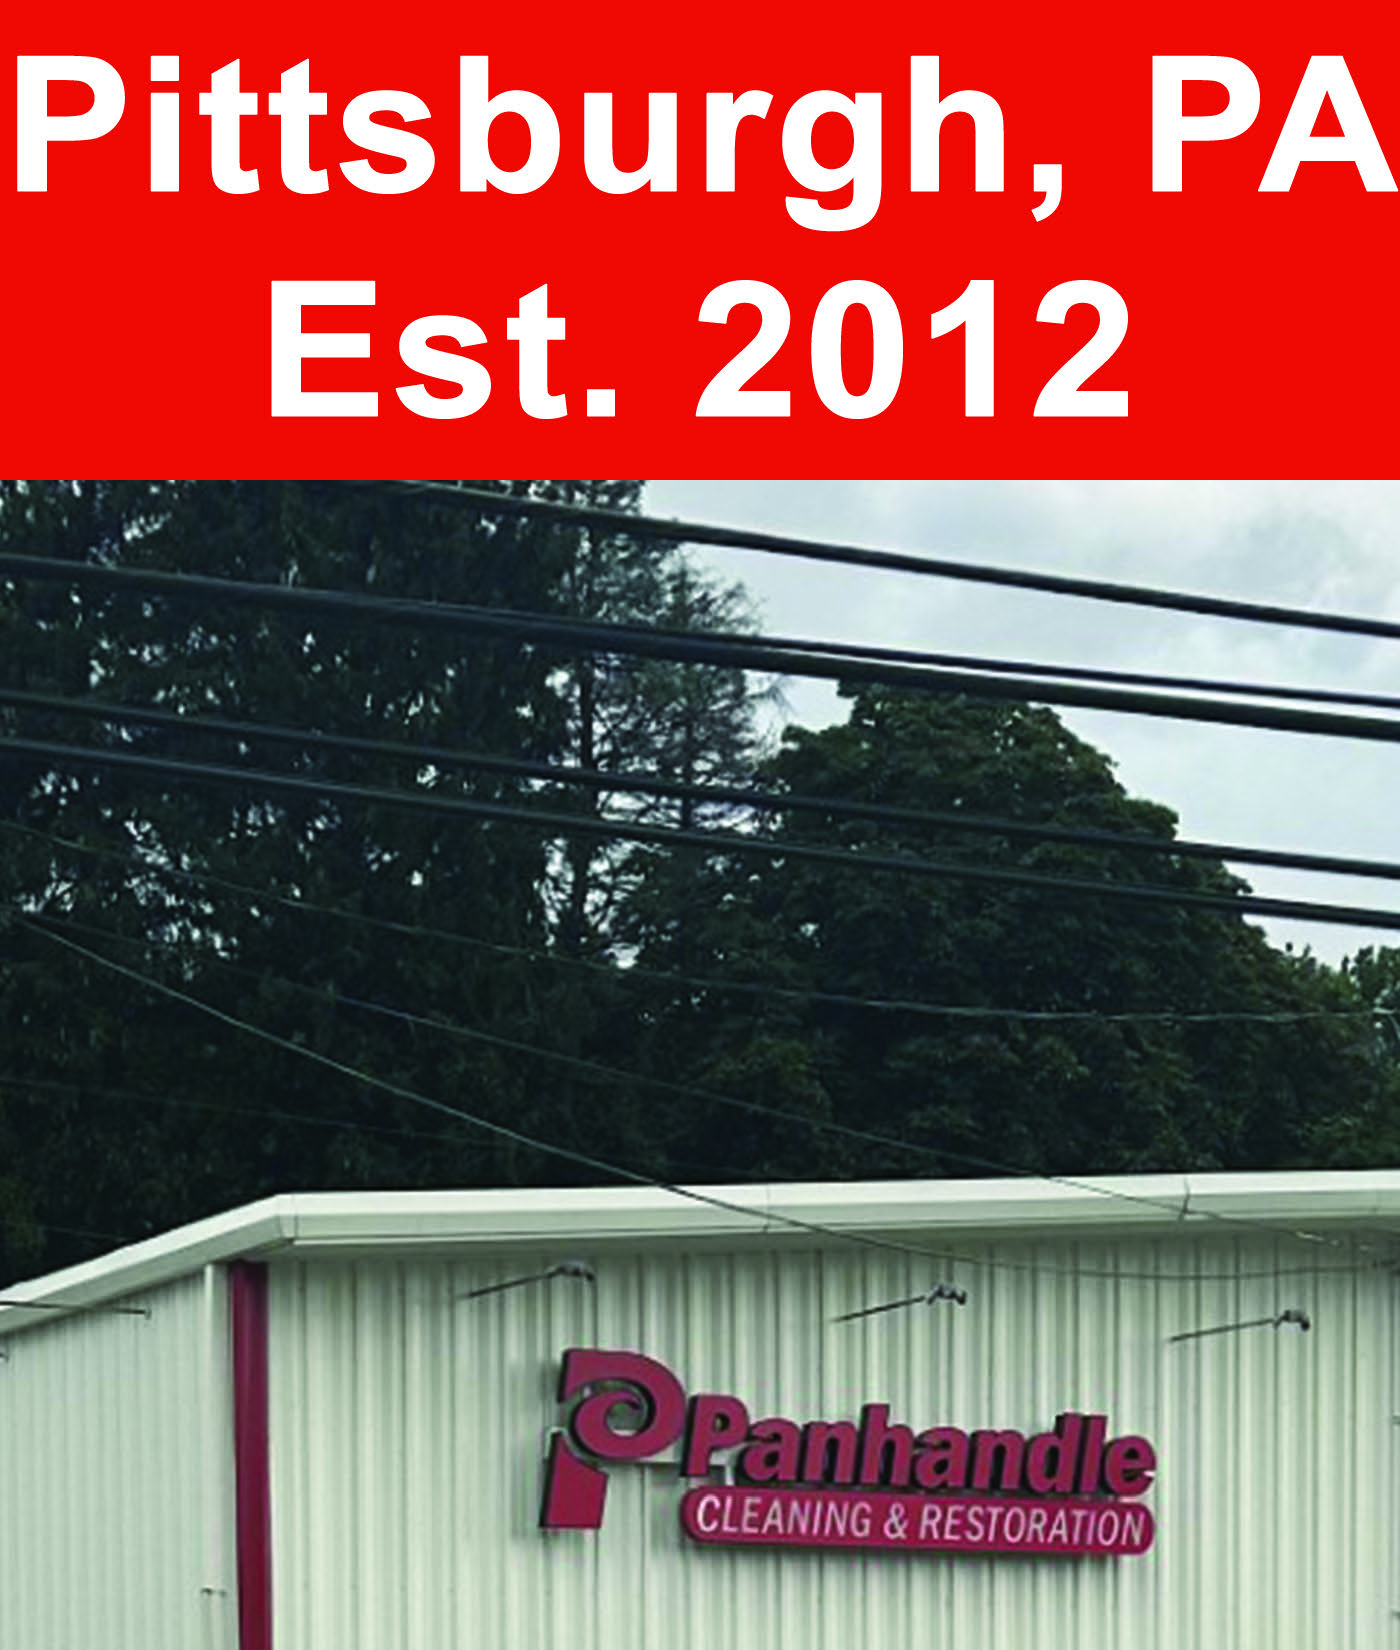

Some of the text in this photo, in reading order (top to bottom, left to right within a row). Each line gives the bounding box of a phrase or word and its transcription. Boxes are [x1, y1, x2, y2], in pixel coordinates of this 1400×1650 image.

[680, 1394, 1157, 1497] Panhandle
[696, 1494, 1145, 1546] CLEANING & RESTORATION
